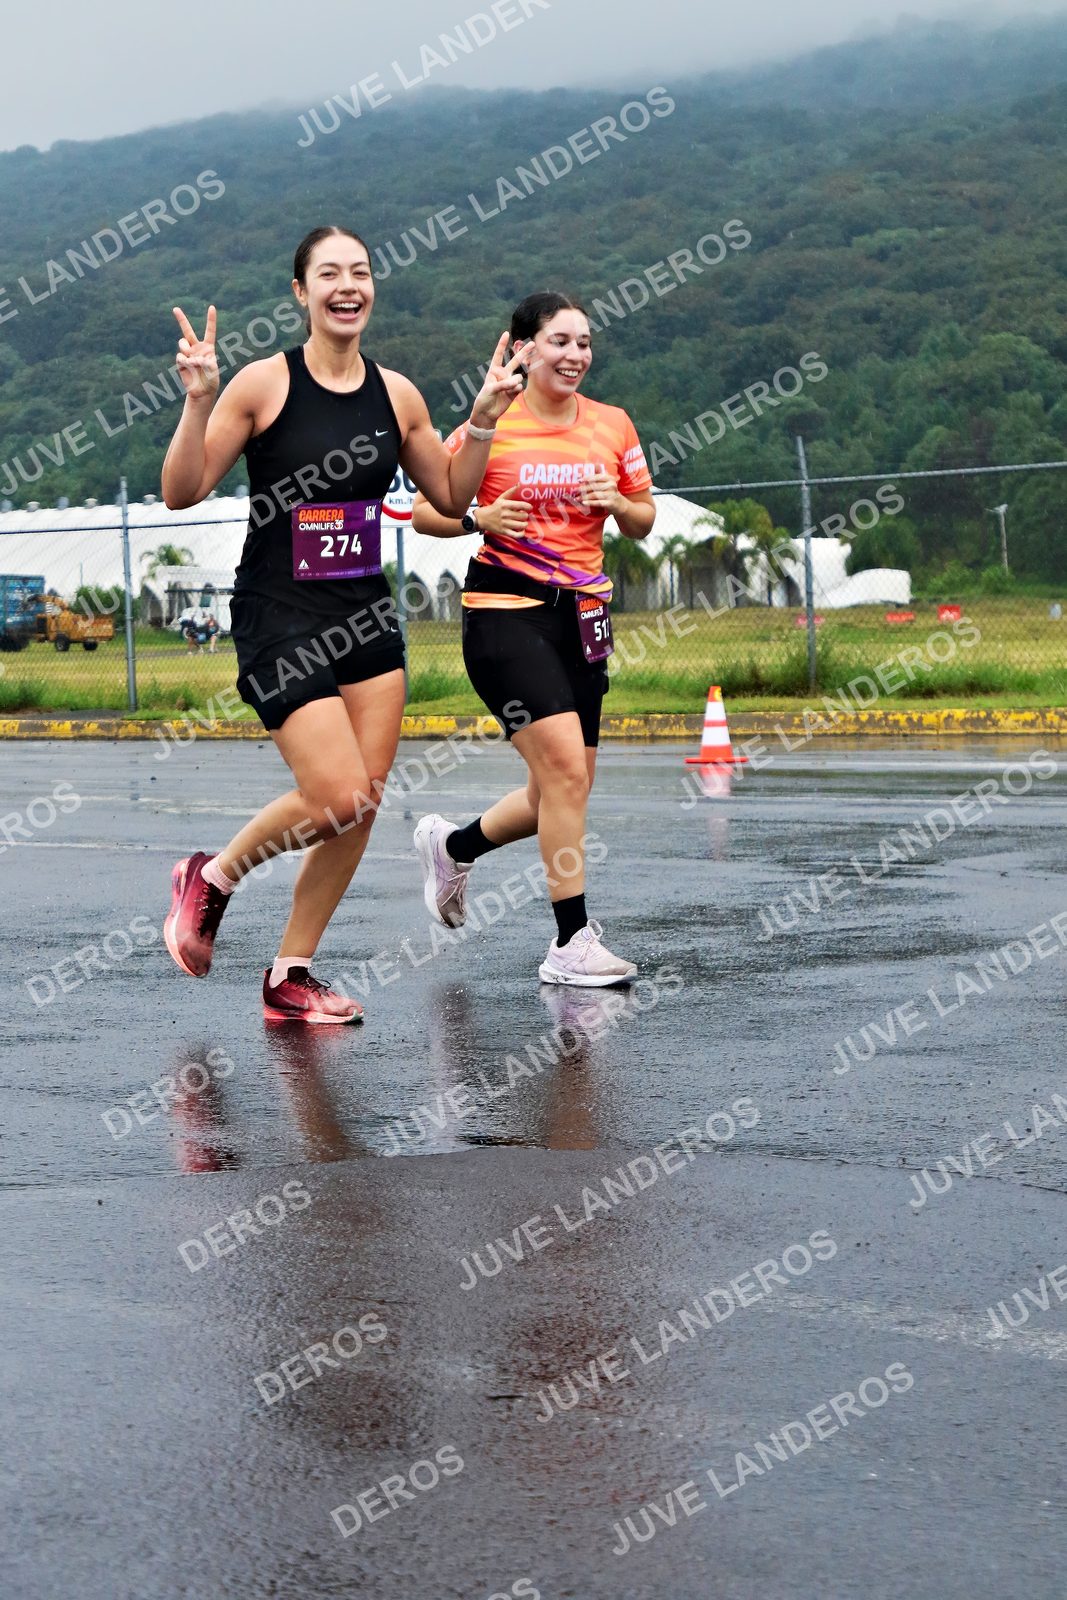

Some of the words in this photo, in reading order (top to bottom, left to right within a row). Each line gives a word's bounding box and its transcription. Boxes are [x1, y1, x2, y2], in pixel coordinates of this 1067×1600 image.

[298, 509, 344, 522] CARRERA
[299, 522, 334, 530] OMNILIFE
[320, 534, 362, 557] 274
[594, 618, 609, 641] 51
